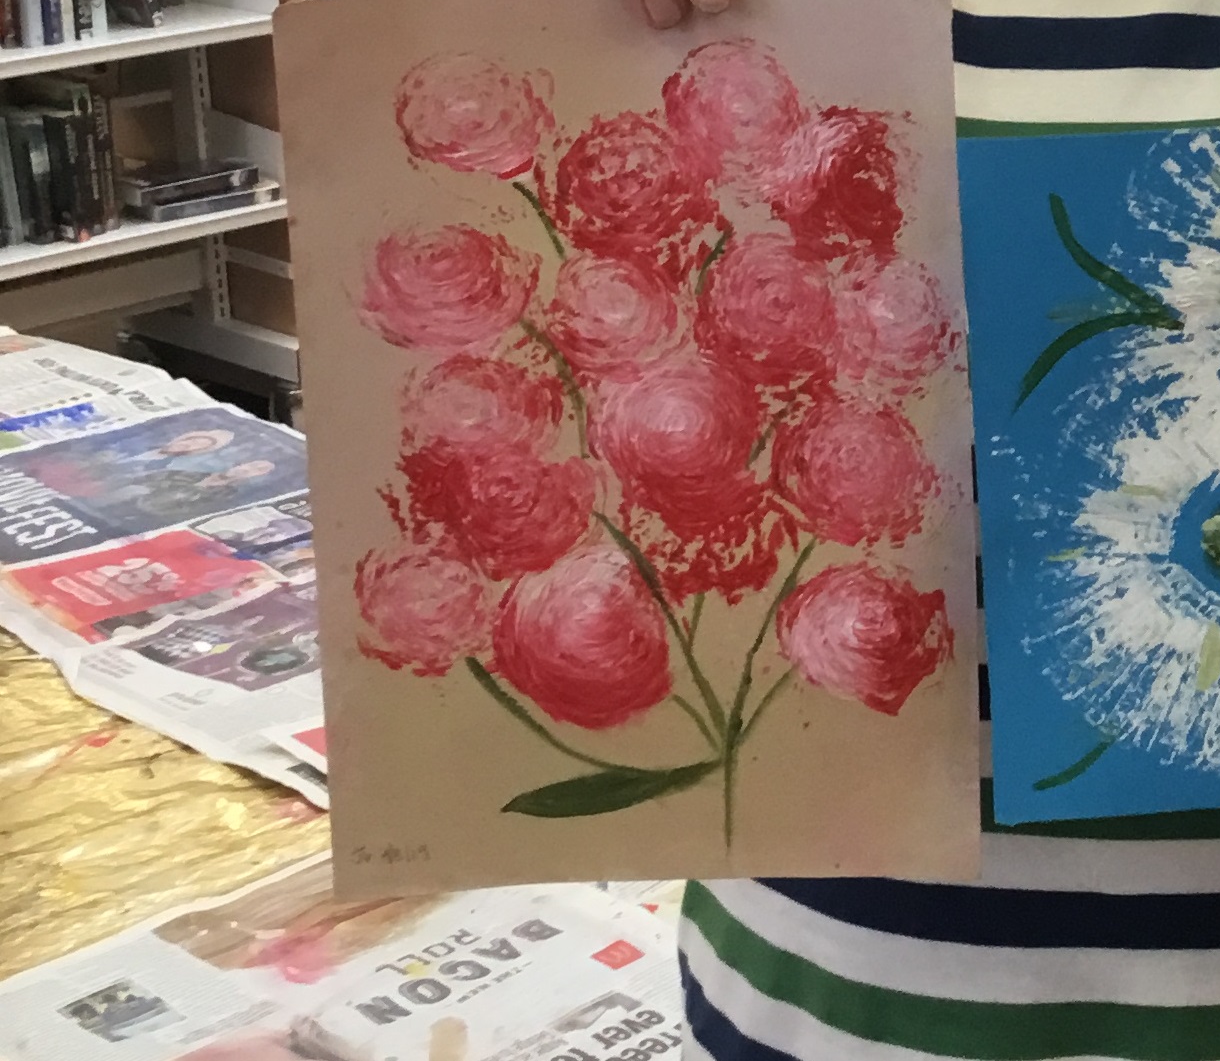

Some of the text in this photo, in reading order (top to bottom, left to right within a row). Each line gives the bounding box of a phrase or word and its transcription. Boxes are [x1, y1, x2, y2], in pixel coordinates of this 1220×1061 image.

[355, 918, 564, 1026] BACON
[375, 928, 481, 976] ROLL
[591, 1009, 666, 1050] ever
